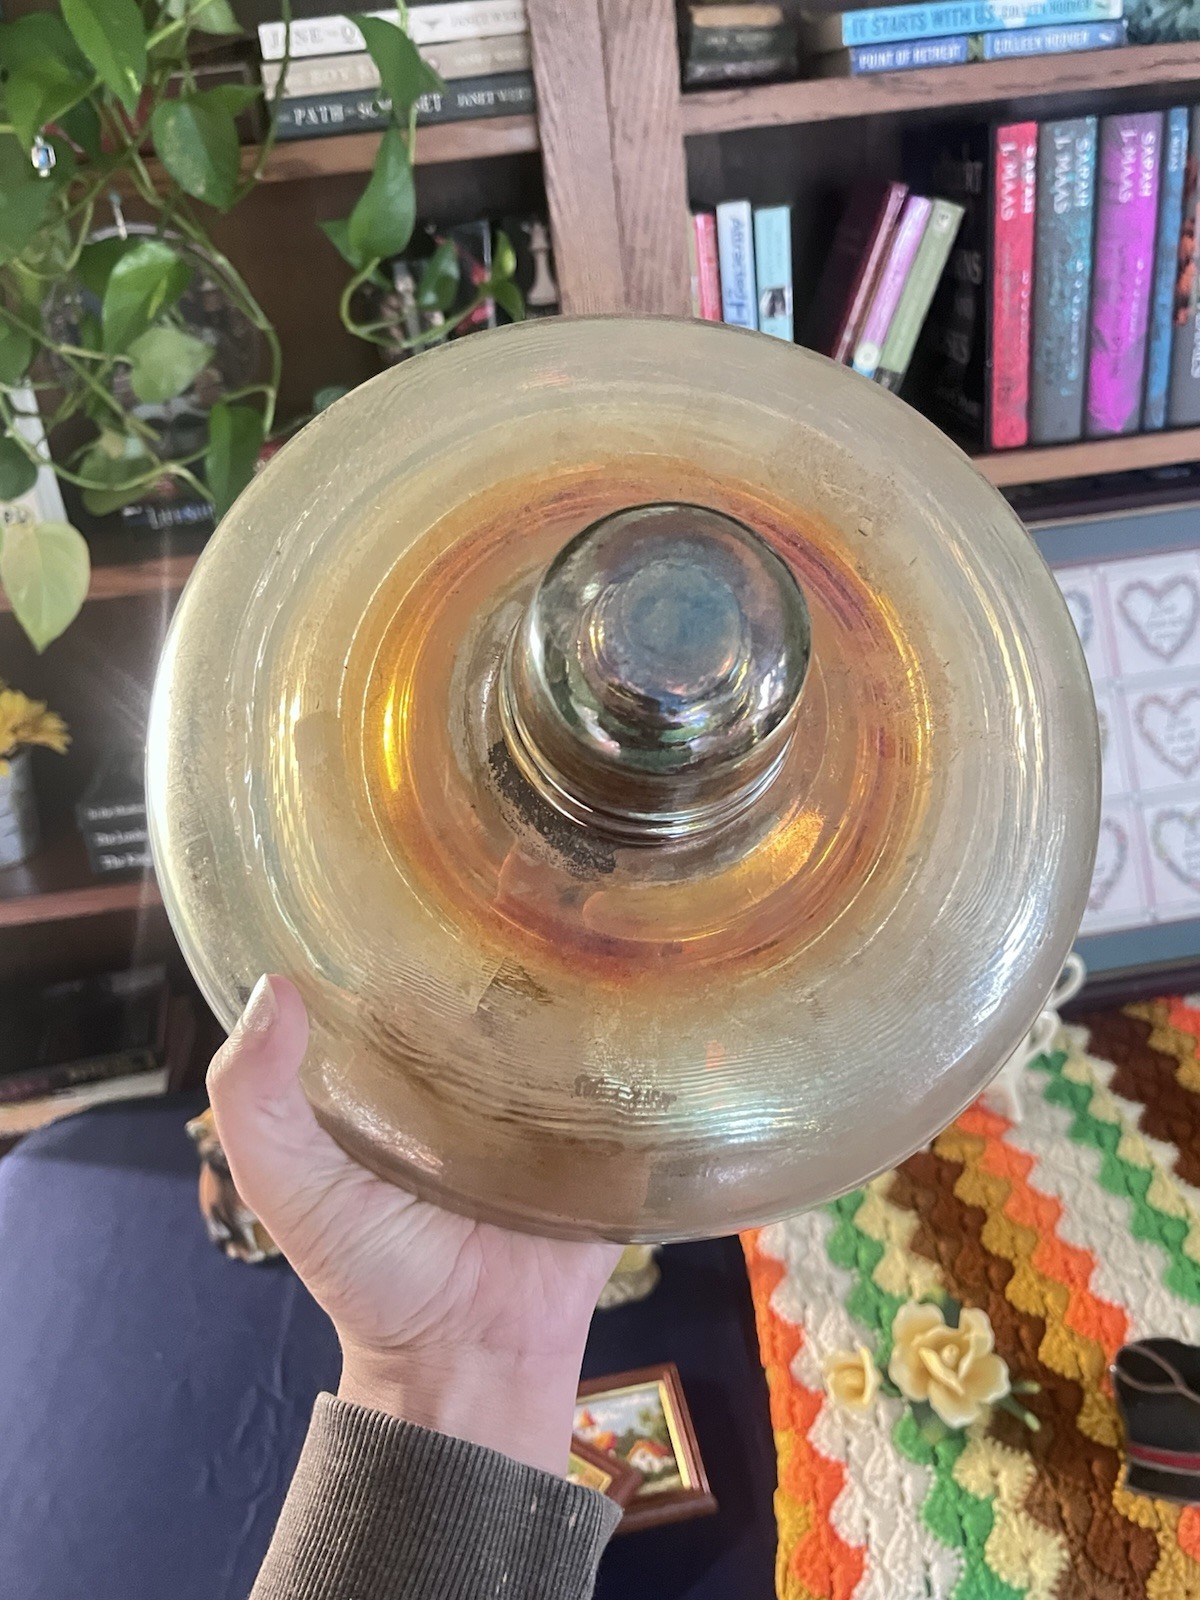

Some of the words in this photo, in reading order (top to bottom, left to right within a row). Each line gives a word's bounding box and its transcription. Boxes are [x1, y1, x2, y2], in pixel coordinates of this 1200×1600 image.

[852, 18, 866, 38] IT
[871, 12, 928, 36] STARTS
[930, 6, 972, 29] WITH
[974, 4, 997, 25] US
[993, 35, 1041, 54] COLLEEN
[1042, 30, 1089, 49] HOOVER
[859, 51, 894, 70] POINT
[895, 48, 912, 65] OF
[1000, 159, 1017, 221] MAAS
[1053, 152, 1072, 214] MAAS
[1075, 136, 1092, 208] SARAH
[1119, 145, 1137, 204] MAAS
[1138, 131, 1157, 198] SARAH
